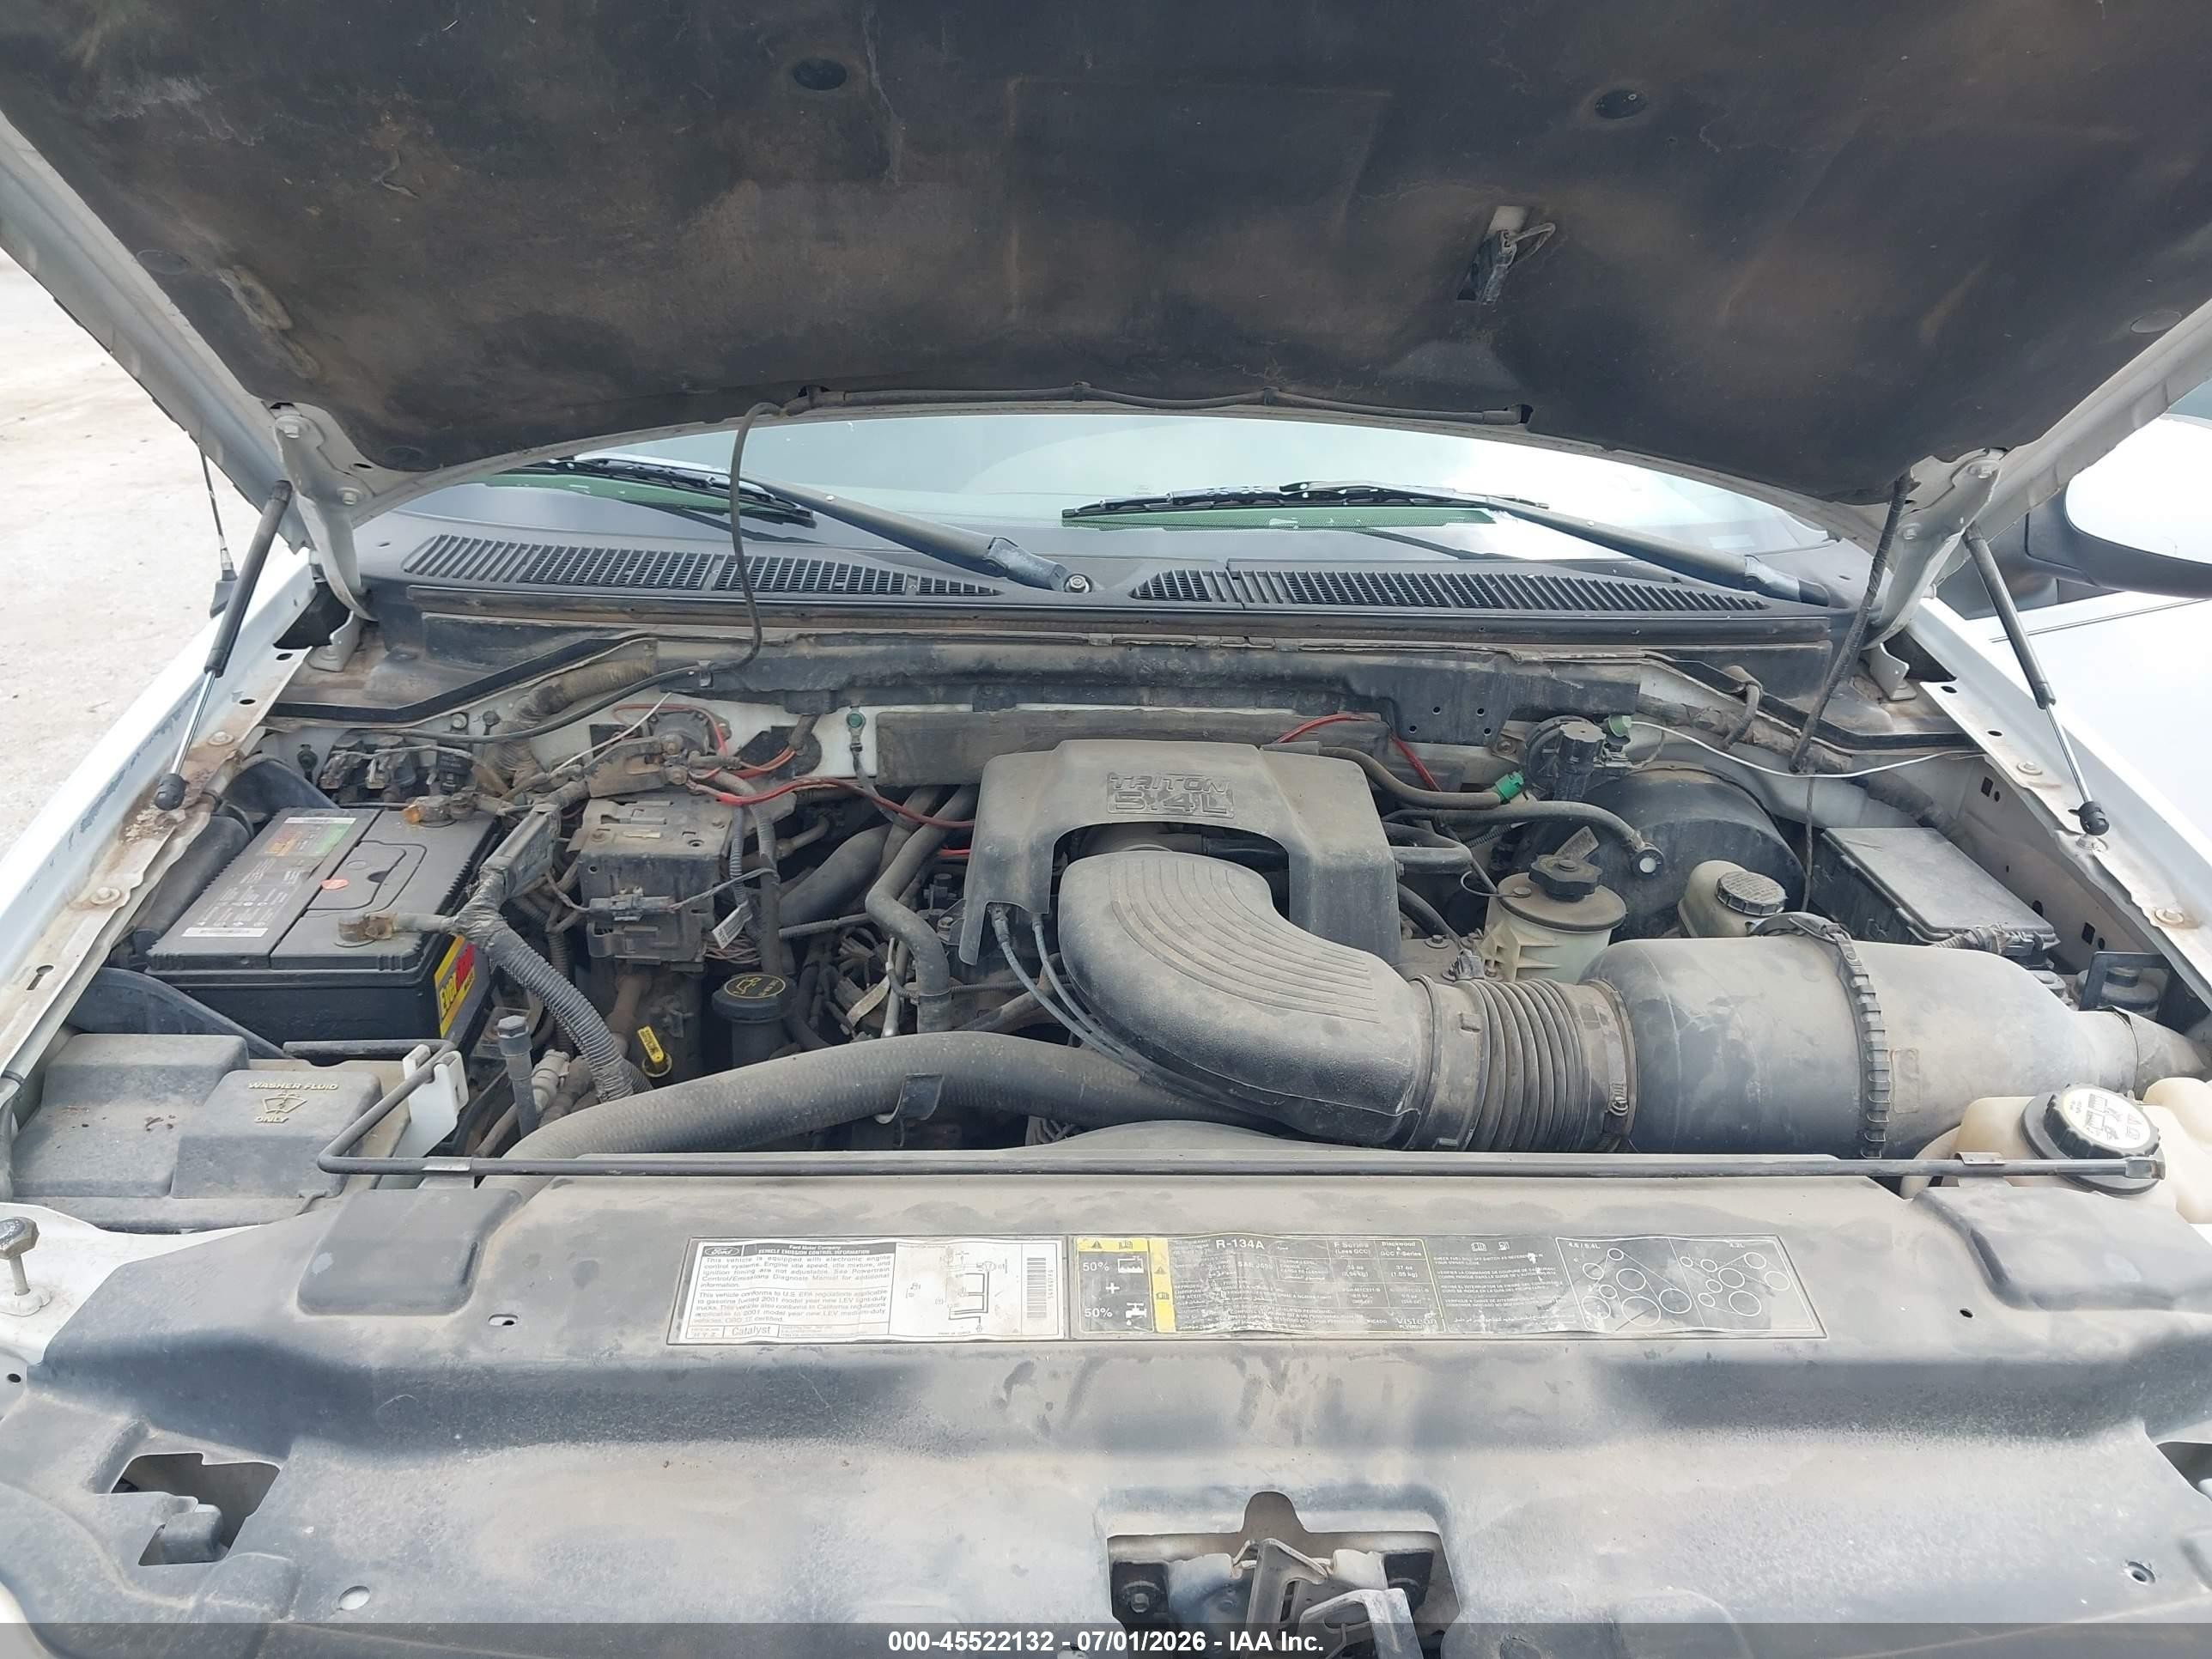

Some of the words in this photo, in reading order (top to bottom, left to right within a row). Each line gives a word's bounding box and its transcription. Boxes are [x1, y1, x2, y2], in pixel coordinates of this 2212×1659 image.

[1109, 775, 1228, 792] TRITON
[1115, 791, 1227, 814] 5.4L
[1216, 1239, 1265, 1249] R-134A
[1083, 1262, 1109, 1272] 50%
[1085, 1308, 1113, 1317] 50%
[732, 1325, 771, 1335] Catalyst
